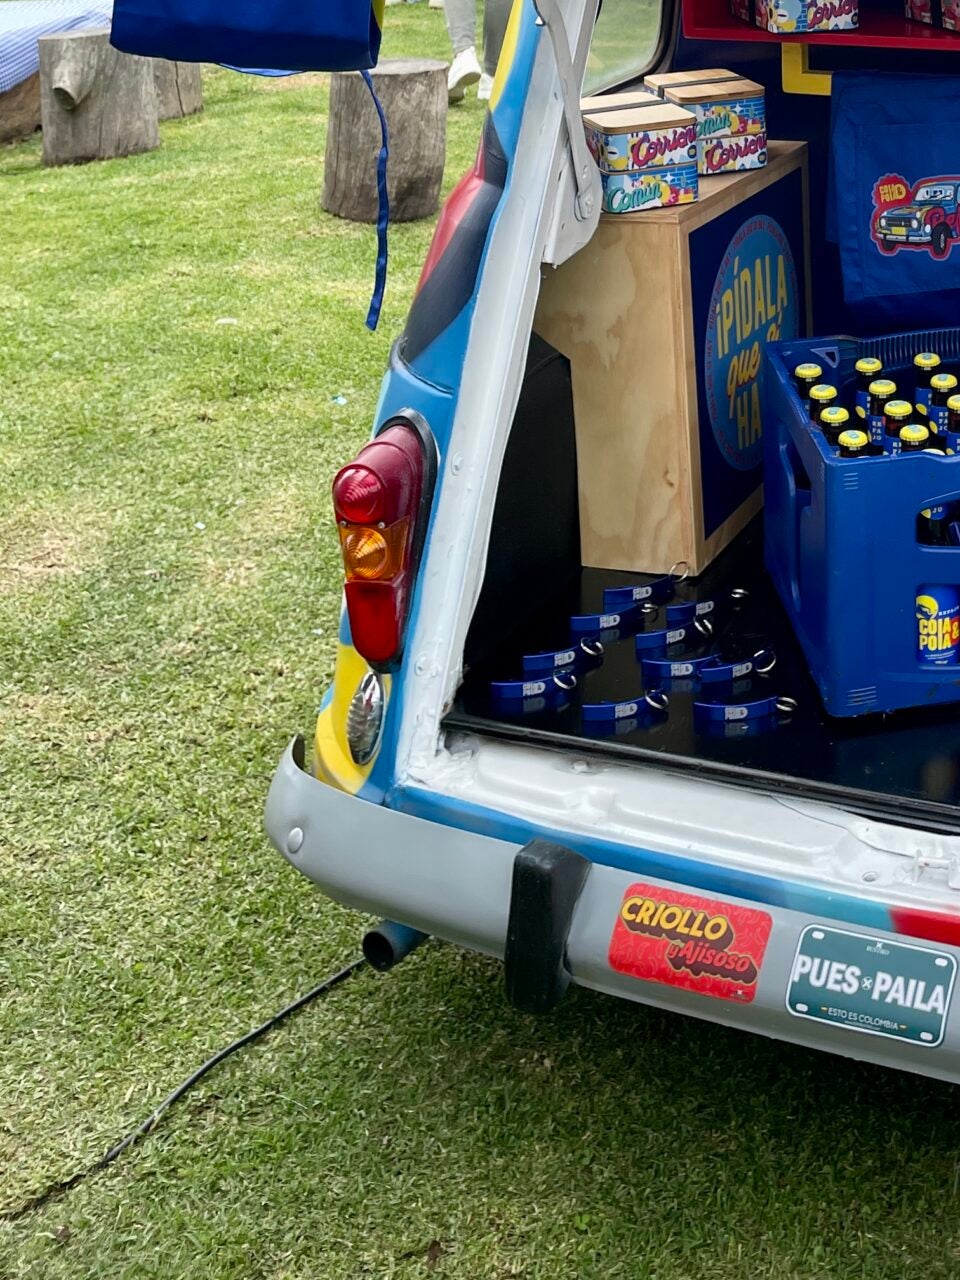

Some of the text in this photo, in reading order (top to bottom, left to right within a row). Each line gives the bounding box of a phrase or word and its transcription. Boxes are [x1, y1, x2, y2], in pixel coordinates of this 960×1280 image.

[919, 617, 952, 635] COLA
[919, 633, 952, 651] POLA
[621, 896, 728, 941] CRIOLLO
[679, 940, 751, 973] Ajisoso
[793, 953, 945, 1015] PUES PAILA
[828, 1006, 848, 1019] ESTO
[848, 1010, 858, 1021] ES
[858, 1013, 900, 1031] COLOMBIA
